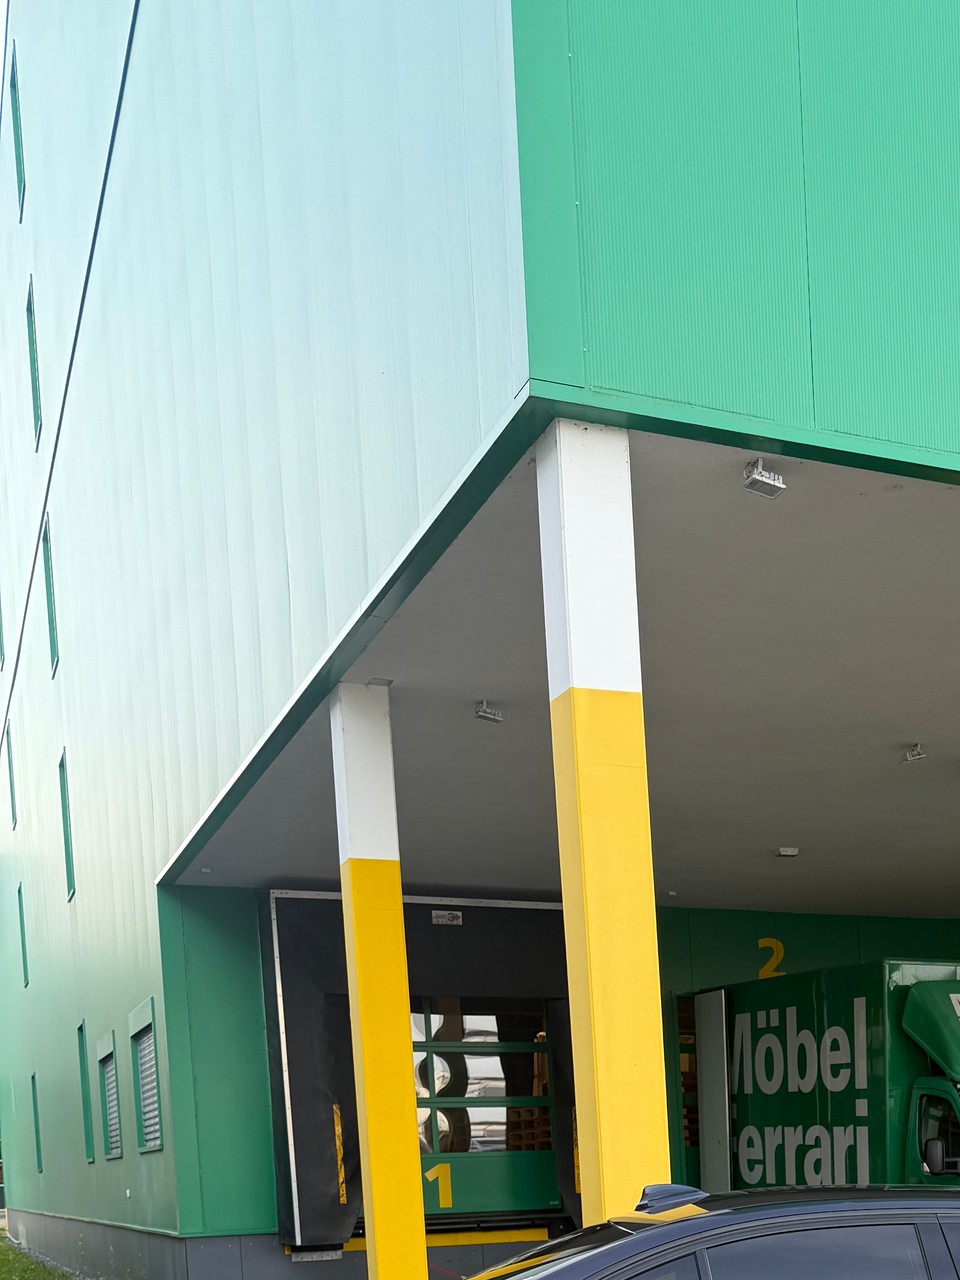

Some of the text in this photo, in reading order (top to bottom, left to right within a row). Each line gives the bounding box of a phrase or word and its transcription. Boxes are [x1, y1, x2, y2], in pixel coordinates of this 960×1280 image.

[757, 938, 786, 980] 2
[732, 1098, 870, 1188] errari
[424, 1163, 453, 1208] 1
